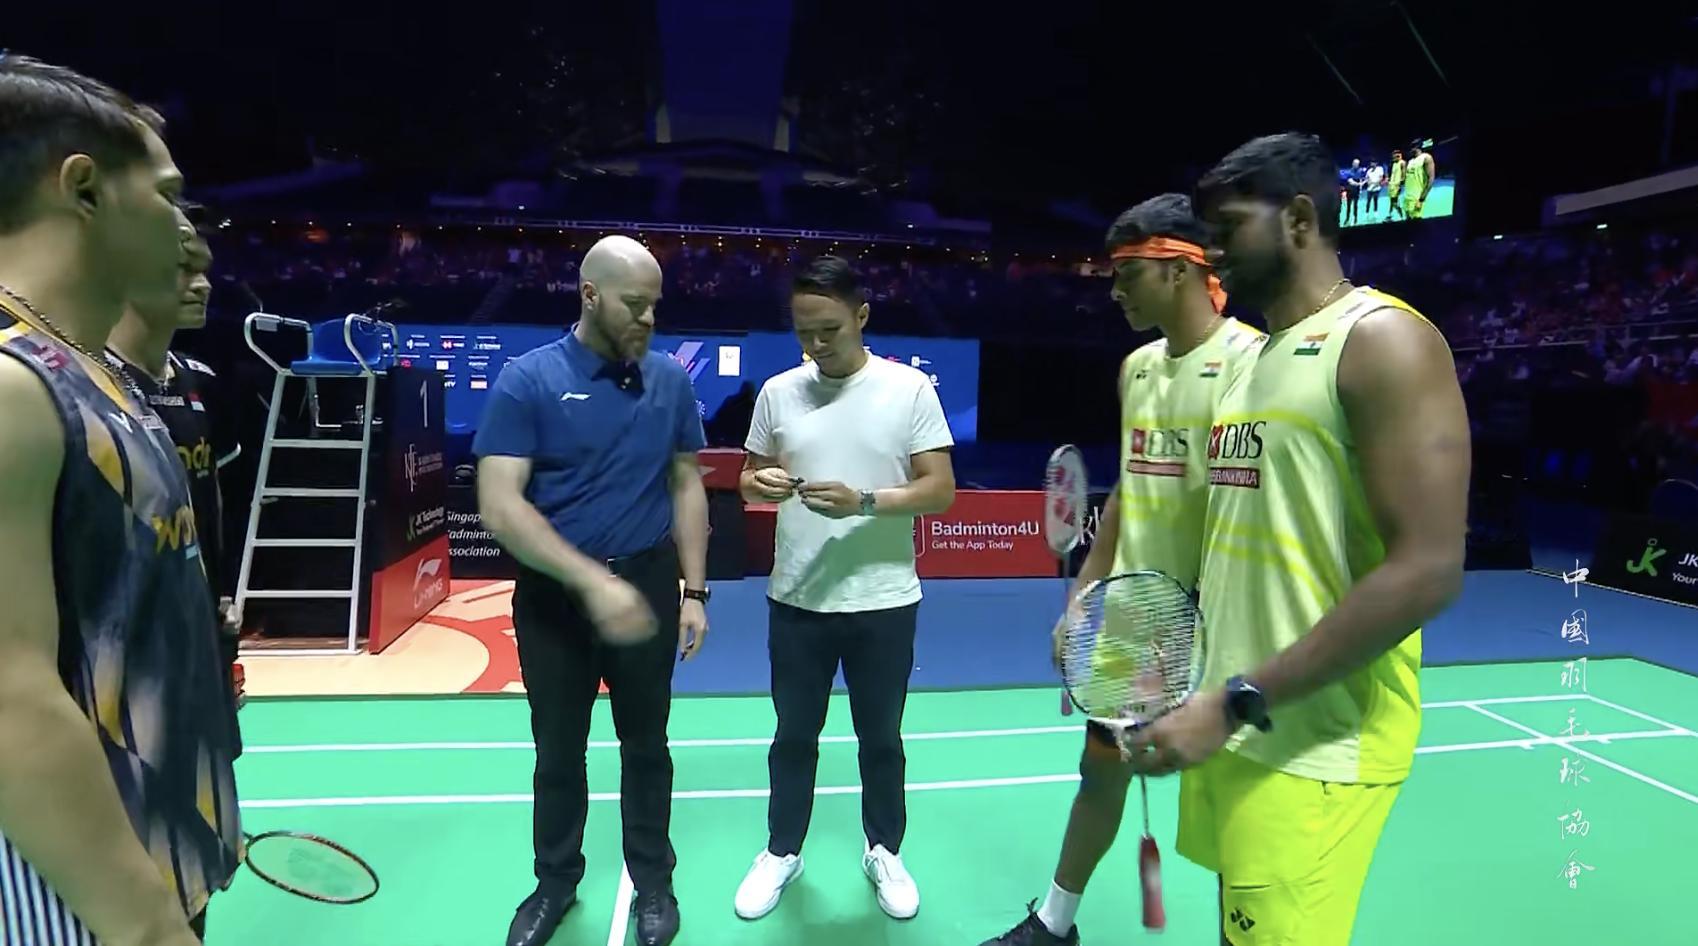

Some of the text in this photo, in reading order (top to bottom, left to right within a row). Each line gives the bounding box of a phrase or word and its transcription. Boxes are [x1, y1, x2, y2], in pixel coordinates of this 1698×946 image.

[419, 380, 429, 428] 1
[1221, 420, 1267, 459] DBS
[447, 511, 481, 524] Singap
[448, 529, 496, 540] adminto
[931, 520, 1039, 536] Badminton4U
[448, 545, 500, 557] ssociation
[931, 540, 1014, 551] Get the App Today
